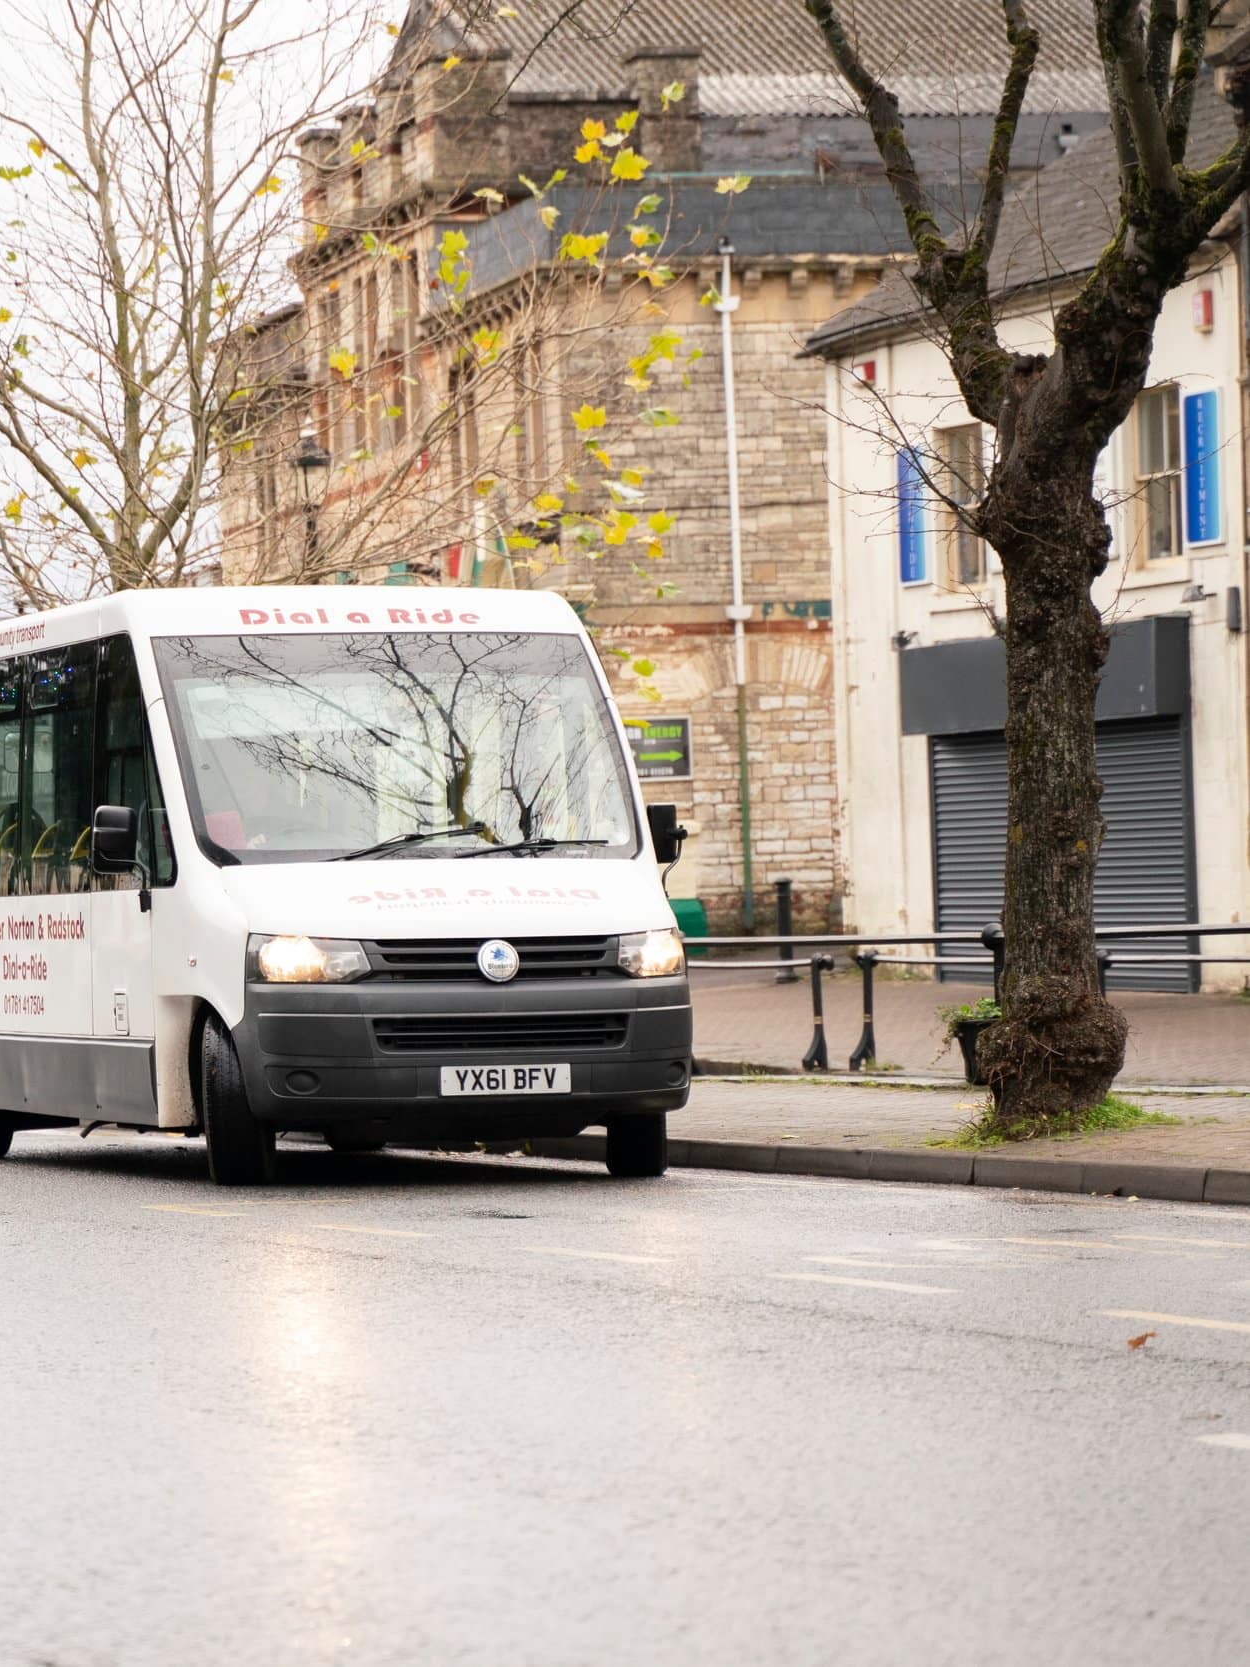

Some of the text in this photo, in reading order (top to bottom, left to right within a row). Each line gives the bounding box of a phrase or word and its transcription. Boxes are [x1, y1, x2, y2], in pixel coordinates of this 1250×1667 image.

[1197, 398, 1207, 539] RECRUITMENT
[239, 608, 481, 625] Dial a Ride
[15, 621, 45, 646] transport
[8, 914, 35, 941] Norton
[38, 913, 44, 940] &
[47, 911, 85, 941] Radstock
[3, 953, 47, 981] Dial-a-Ride
[4, 994, 45, 1015] 01761 417504
[455, 1067, 556, 1091] YX61 BFV
